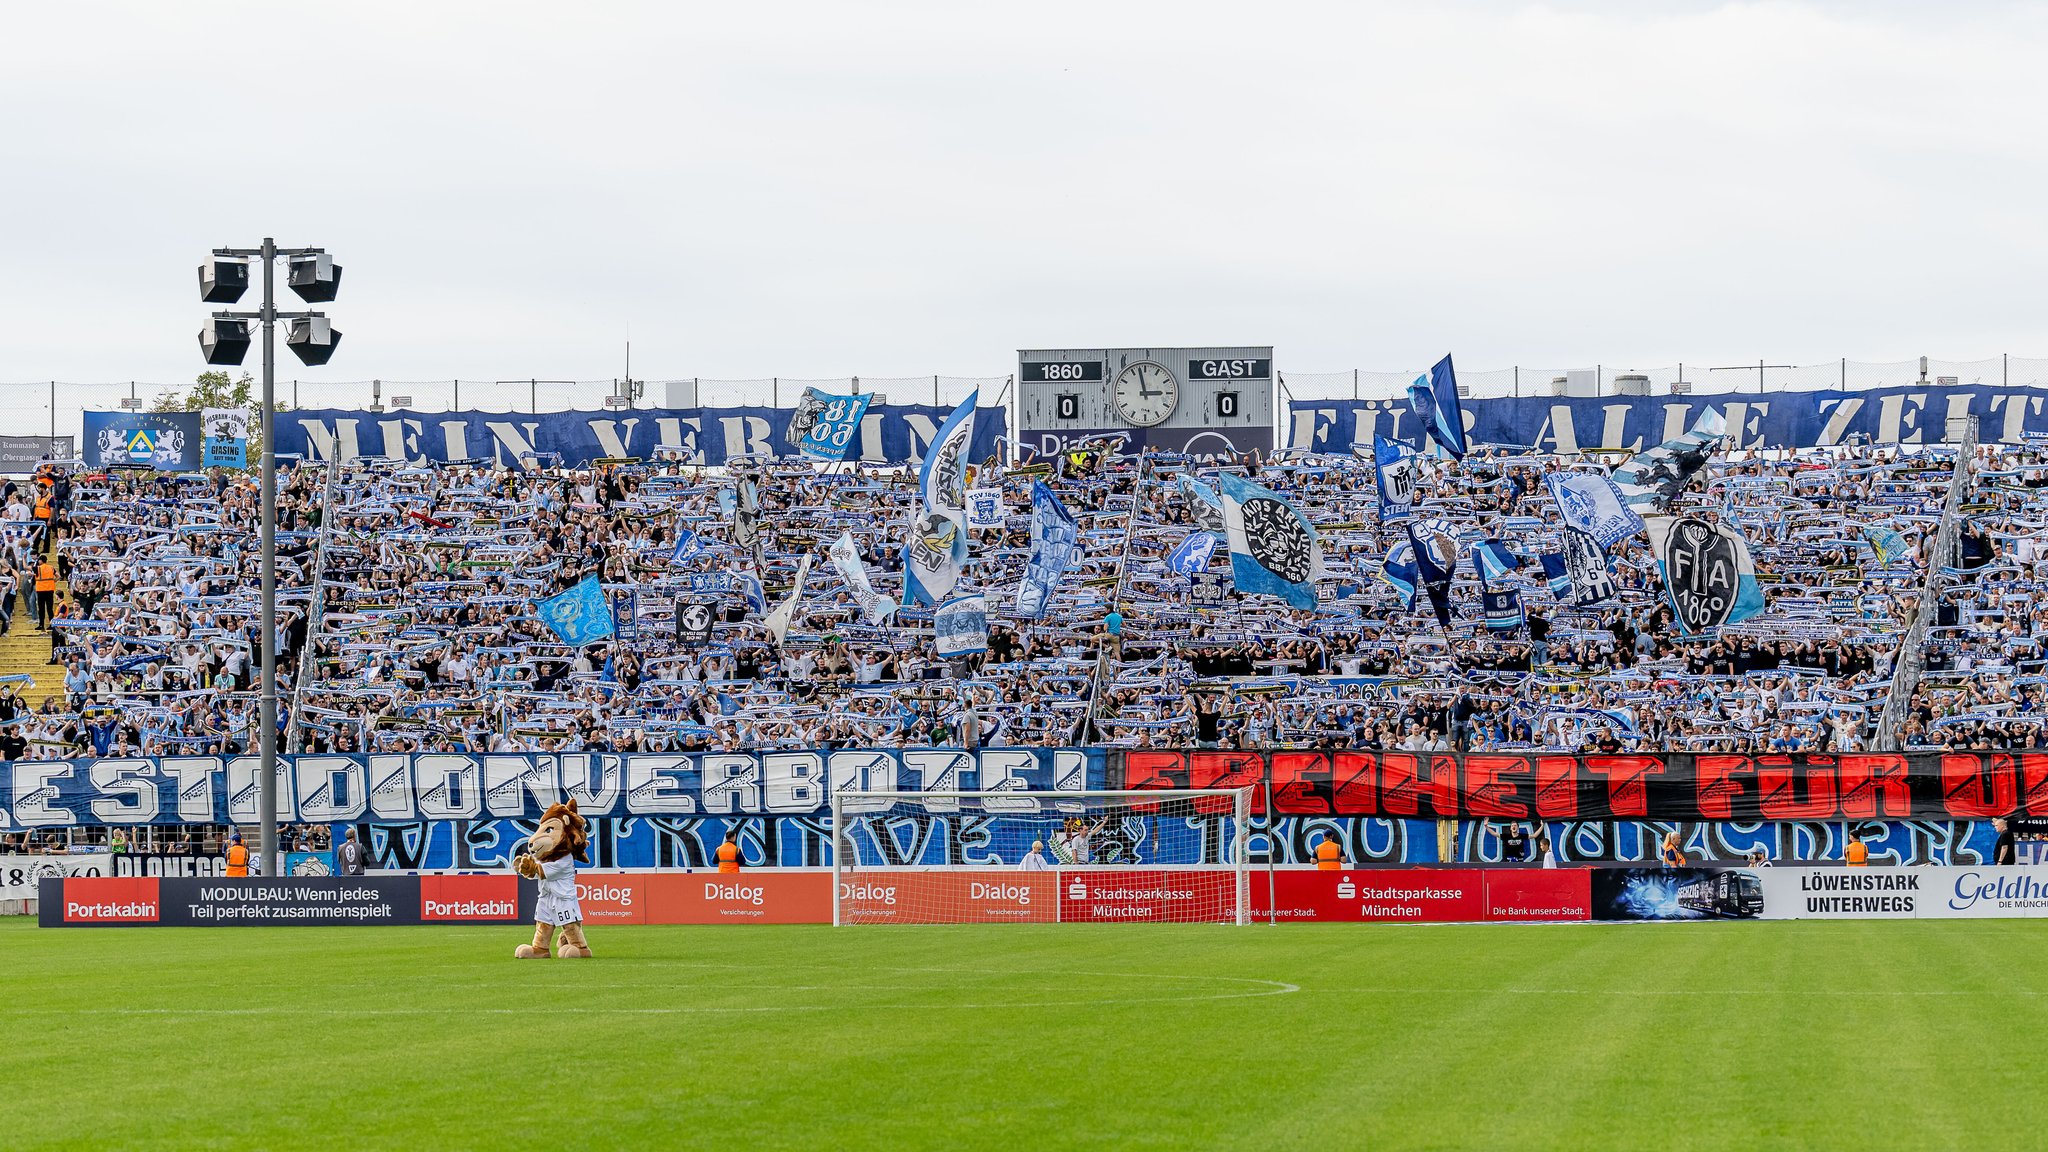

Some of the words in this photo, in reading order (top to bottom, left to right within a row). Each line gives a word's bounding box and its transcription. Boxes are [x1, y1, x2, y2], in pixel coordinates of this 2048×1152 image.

[1041, 364, 1083, 380] 1860
[1201, 360, 1256, 377] GAST
[1062, 398, 1073, 417] 0
[1222, 396, 1233, 415] 0
[298, 418, 541, 472] MEIN
[588, 413, 950, 467] VERIN
[1532, 401, 1771, 456] ALLE
[1814, 393, 2047, 448] ZEIT
[2, 441, 40, 449] Kommando
[211, 445, 240, 456] GIASING
[969, 493, 984, 501] TSV
[1242, 500, 1271, 518] KIDS
[1275, 504, 1301, 531] ARE
[1678, 588, 1724, 626] 1860
[1124, 751, 1666, 820] FREIHEIT
[1694, 752, 1913, 820] FÜR
[1801, 872, 1920, 892] LÖWENSTARK
[201, 887, 292, 902] MODULBAU:
[295, 887, 337, 901] Wenn
[338, 887, 380, 904] jedes
[704, 883, 764, 906] Dialog
[970, 883, 1031, 905] Dialog
[1093, 888, 1193, 902] Stadtsparkasse
[1362, 887, 1463, 901] Stadtsparkasse
[67, 901, 156, 918] Portakabin
[189, 904, 214, 918] Teil
[216, 904, 270, 921] perfekt
[272, 904, 391, 920] zusammenspielt
[425, 900, 515, 916] Portakabin
[588, 909, 633, 917] Versicherungen
[719, 908, 765, 917] Versicherungen
[852, 908, 897, 916] Versicherungen
[985, 908, 1031, 916] Versicherungen
[1093, 904, 1152, 917] München
[1293, 908, 1317, 916] Stadt.
[1361, 904, 1422, 917] München
[1493, 907, 1506, 916] Die
[1508, 907, 1528, 916] Bank
[1561, 907, 1586, 917] Stadt.
[1807, 897, 1914, 913] UNTERWEGS
[1998, 901, 2012, 909] DIE
[558, 910, 571, 922] 60
